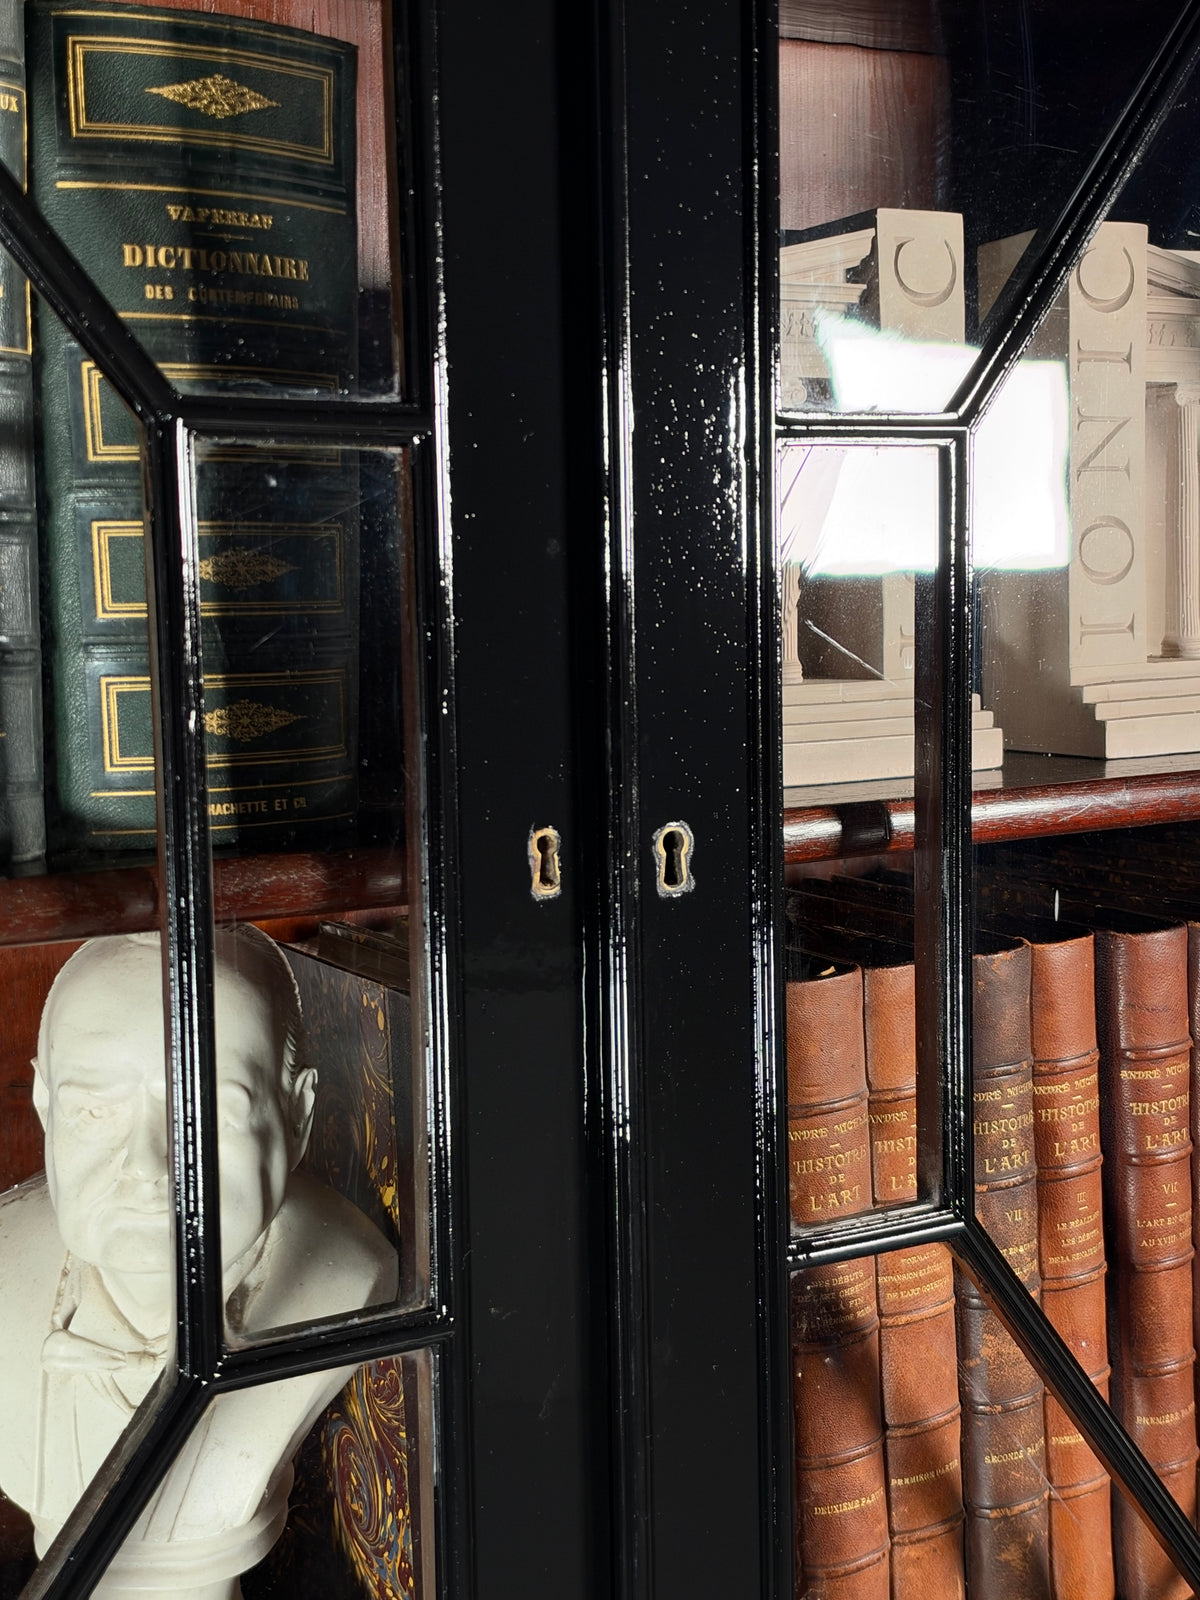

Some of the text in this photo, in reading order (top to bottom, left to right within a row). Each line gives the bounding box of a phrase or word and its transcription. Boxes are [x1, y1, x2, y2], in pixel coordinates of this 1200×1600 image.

[165, 203, 273, 230] VAPEREAU
[122, 243, 309, 281] DICTIONNAIRE
[144, 284, 299, 310] DES CONTEMPORAINS
[1076, 245, 1136, 646] IONIC
[207, 801, 268, 816] HACHETTE
[274, 799, 288, 811] ET
[1071, 1120, 1085, 1132] DE
[1163, 1115, 1177, 1126] DE
[1002, 1137, 1017, 1149] DE
[1054, 1132, 1097, 1157] L'ART
[793, 1143, 866, 1175] HISTOIRE
[985, 1149, 1029, 1173] L'ART
[829, 1173, 845, 1185] DE
[810, 1184, 861, 1211] L'ART
[1005, 1208, 1022, 1222] VII
[832, 1270, 863, 1286] DÉBUTS
